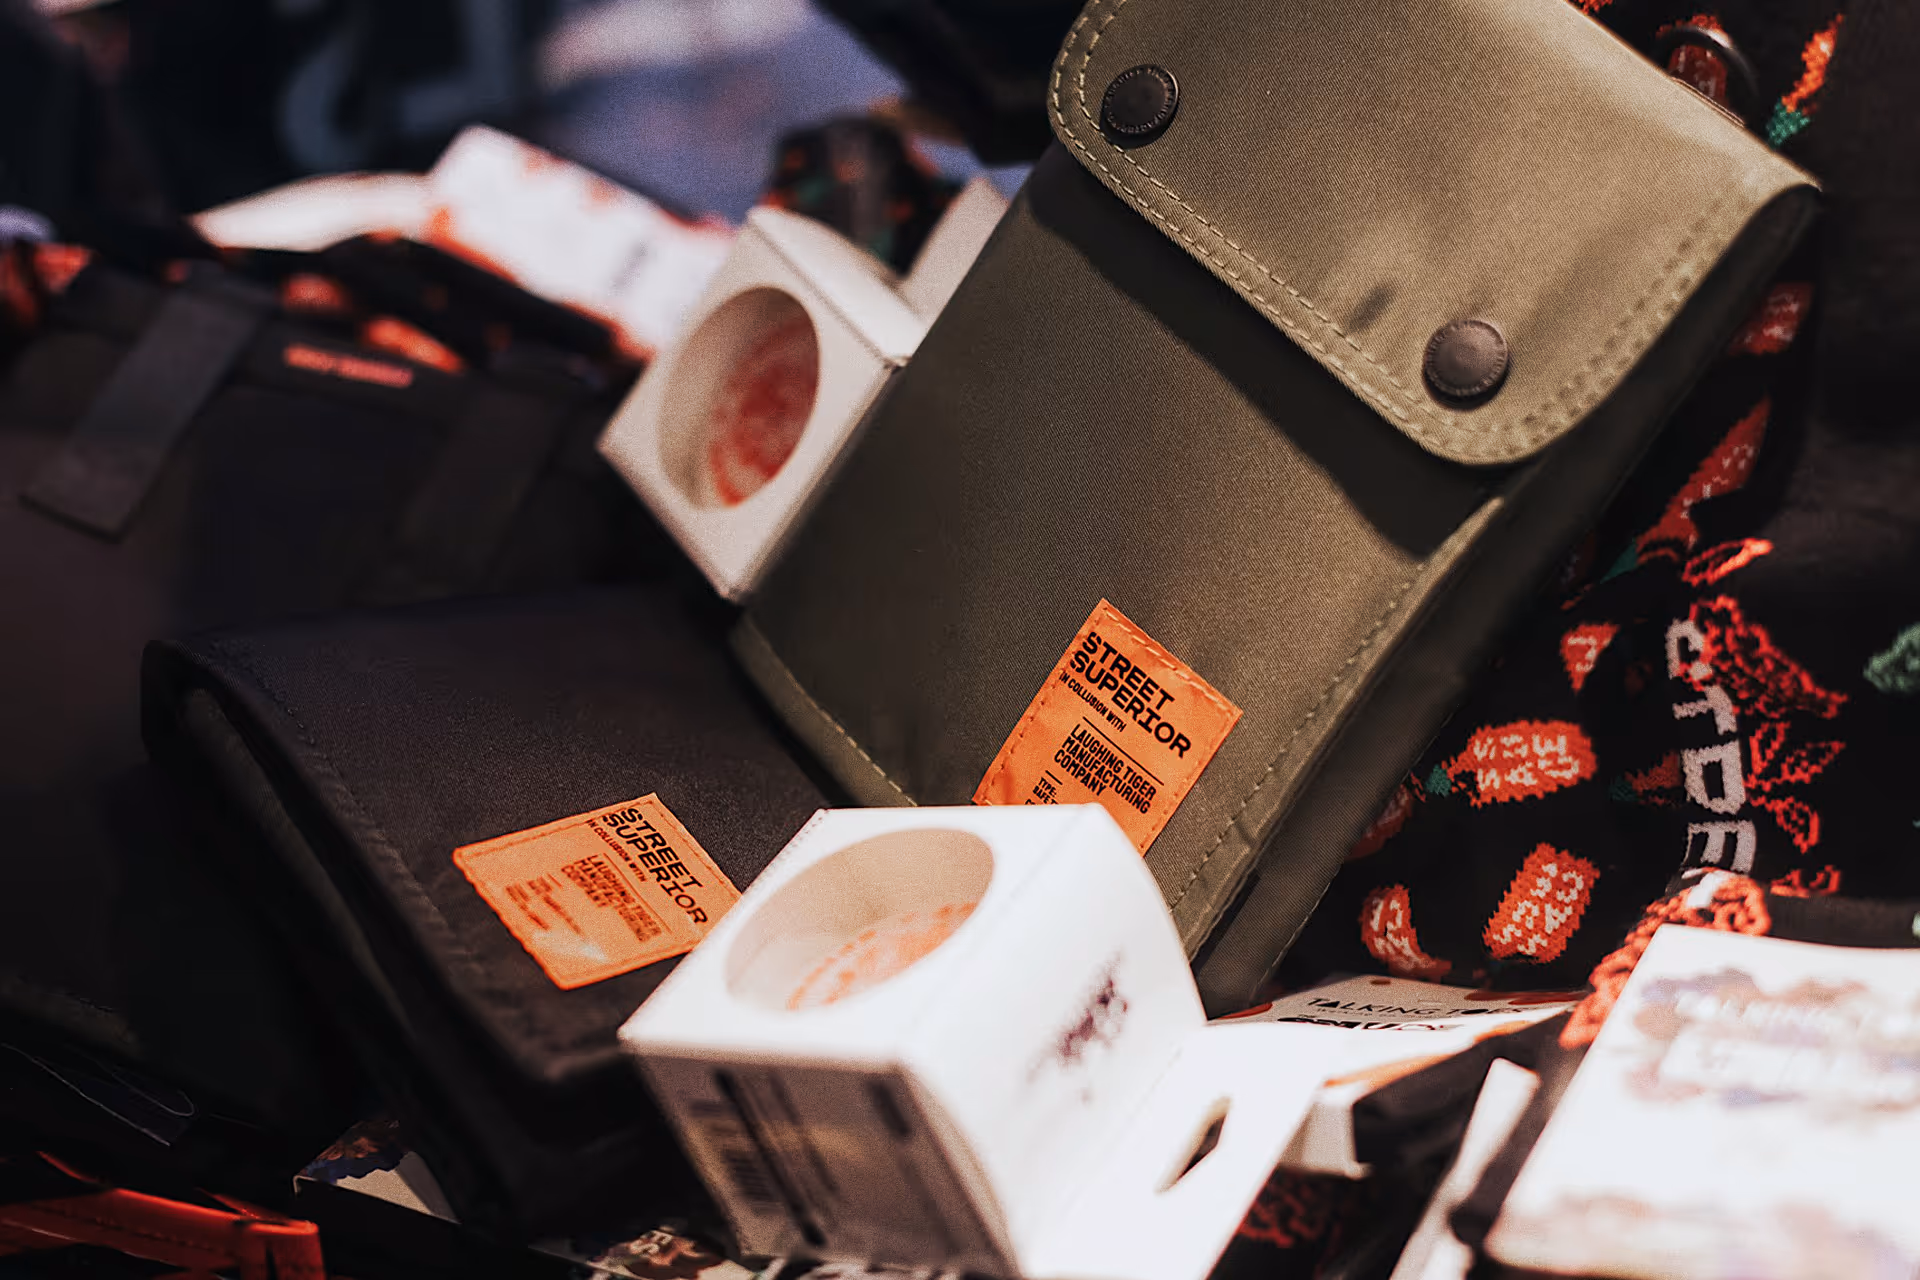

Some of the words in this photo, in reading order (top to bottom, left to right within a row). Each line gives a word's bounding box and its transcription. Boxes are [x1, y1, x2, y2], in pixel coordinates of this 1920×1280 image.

[1059, 672, 1069, 684] IN
[1067, 678, 1109, 717] COLLUSION
[1106, 710, 1127, 732] WITH
[1070, 650, 1191, 758] SUPERIOR
[1082, 632, 1175, 710] STREET
[1054, 749, 1107, 796] COMPANY
[1062, 736, 1151, 814] MANUFACTURING
[1070, 723, 1124, 774] LAUGHING
[1123, 765, 1156, 801] TIGER
[602, 814, 708, 923] SUPERIOR
[621, 808, 703, 887] STREET
[1307, 998, 1441, 1016] TALKING
